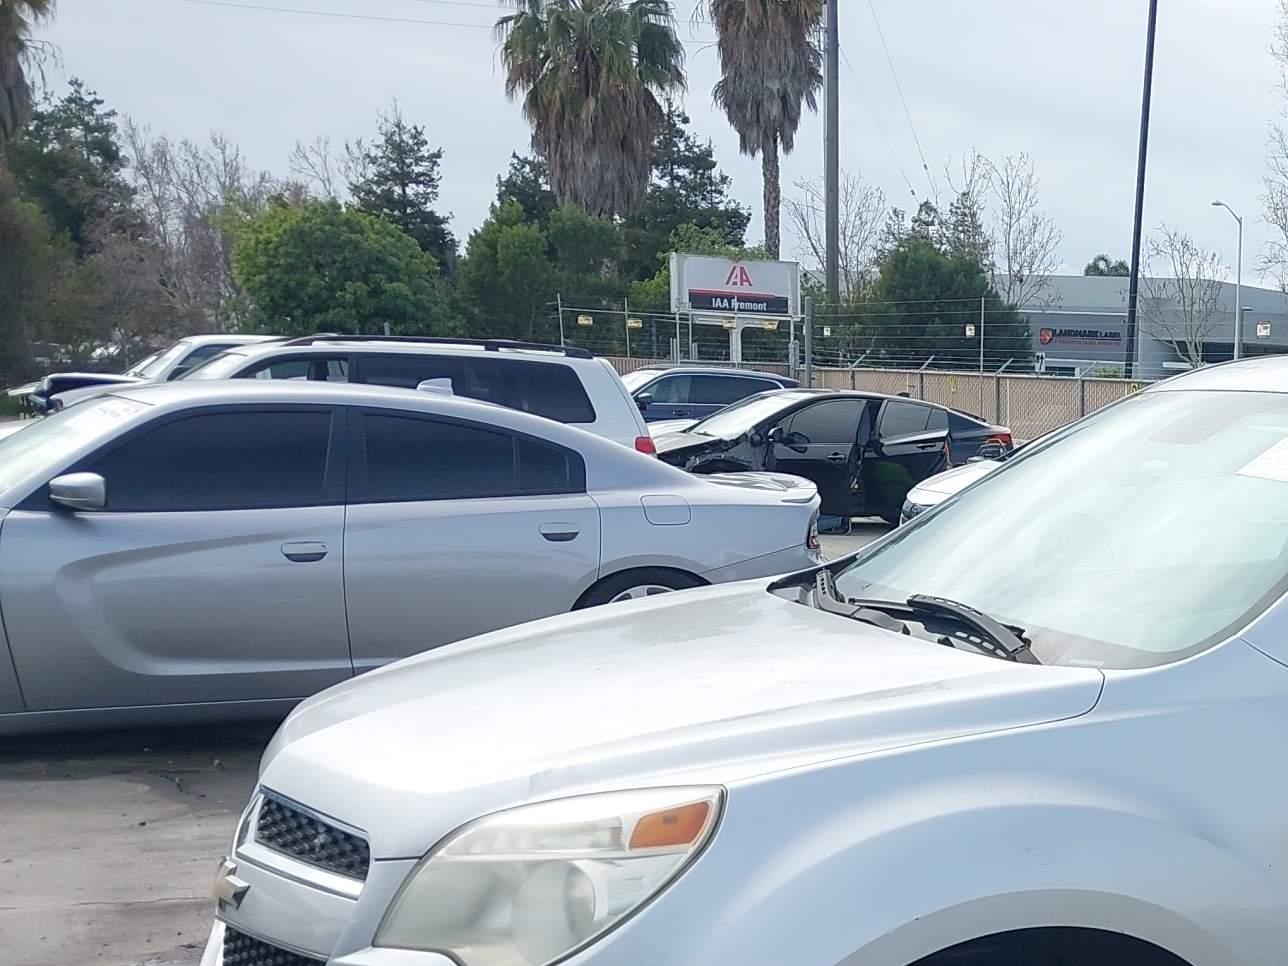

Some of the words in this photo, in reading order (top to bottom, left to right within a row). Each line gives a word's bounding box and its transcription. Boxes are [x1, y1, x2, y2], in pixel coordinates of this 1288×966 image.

[711, 297, 729, 309] IAA
[731, 298, 767, 311] Fremont
[1053, 328, 1099, 338] LANDMARK
